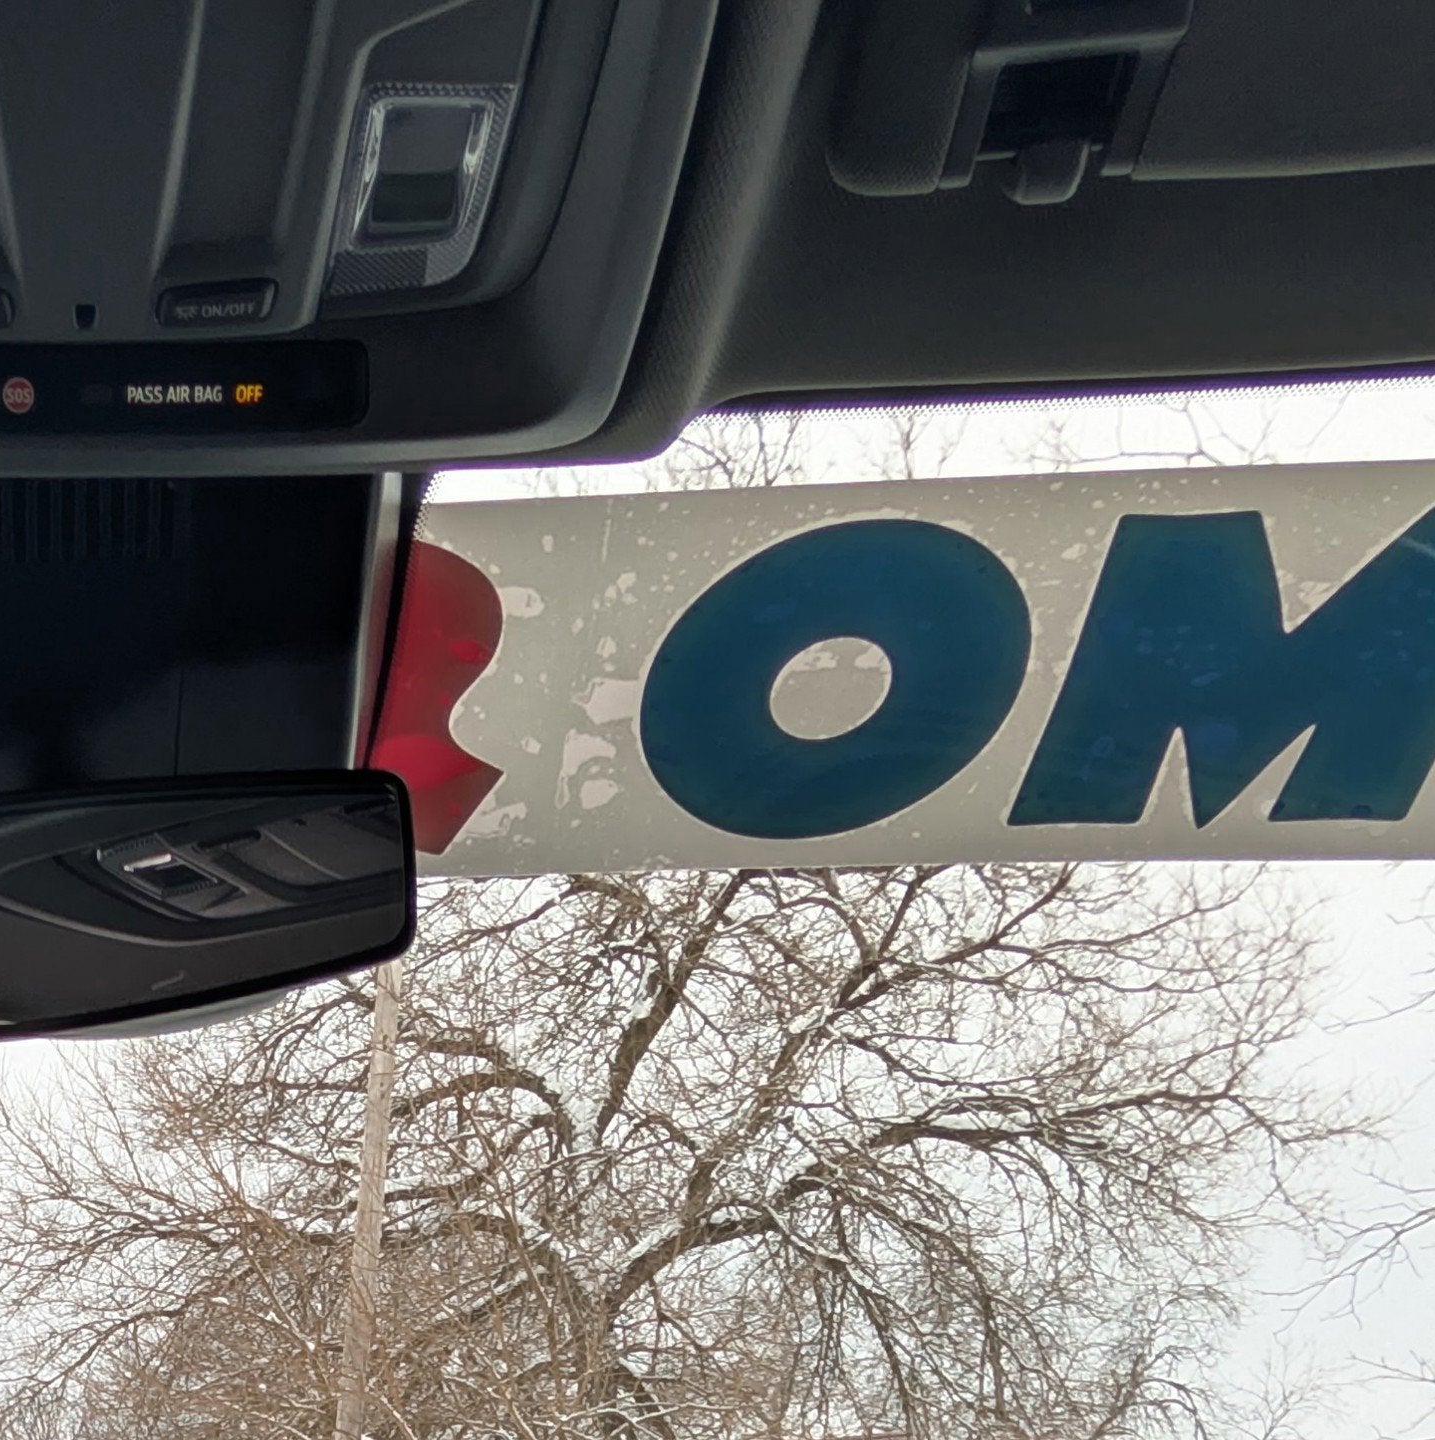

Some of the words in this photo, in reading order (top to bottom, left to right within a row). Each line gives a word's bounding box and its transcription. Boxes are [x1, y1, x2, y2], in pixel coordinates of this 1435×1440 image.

[200, 302, 257, 318] ON/OFF
[6, 386, 33, 403] SOS
[127, 385, 164, 404] PASS
[166, 385, 192, 403] AIR
[194, 385, 224, 404] BAG
[235, 384, 264, 404] OFF
